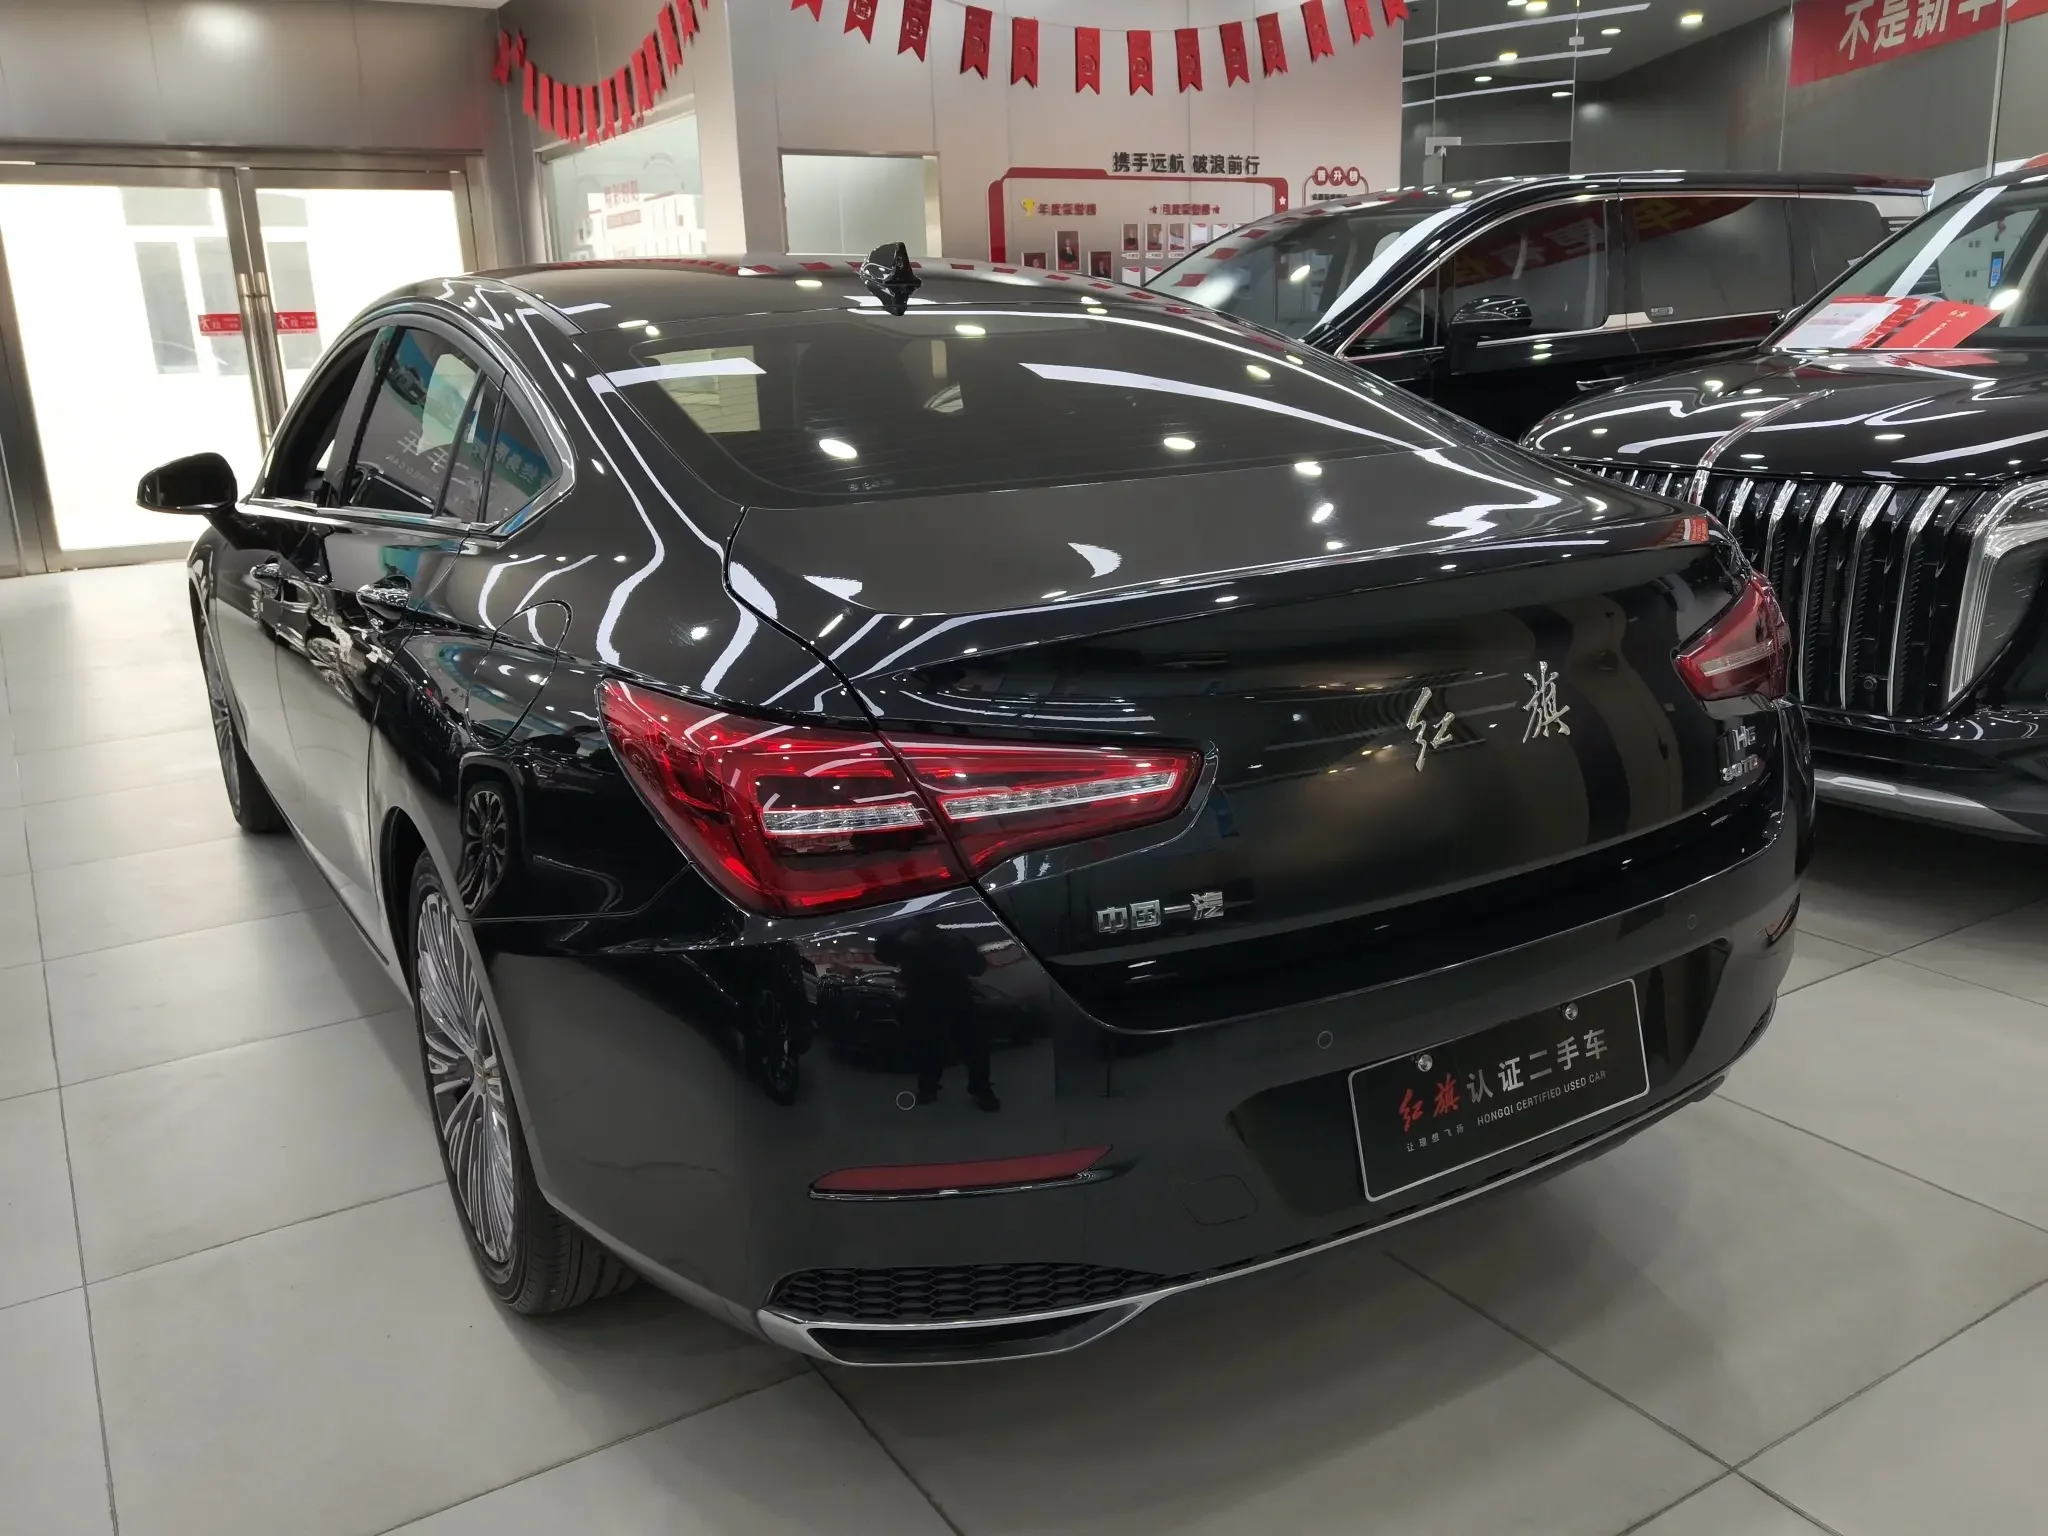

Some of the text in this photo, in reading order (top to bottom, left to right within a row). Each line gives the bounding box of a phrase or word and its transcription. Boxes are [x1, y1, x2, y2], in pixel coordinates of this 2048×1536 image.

[1113, 151, 1260, 175] 携手远航 破浪前行
[1406, 660, 1572, 773] 红旗
[1096, 891, 1225, 934] 中国一汽
[1477, 1069, 1607, 1126] HONGQI CERTIFIED USED CAR
